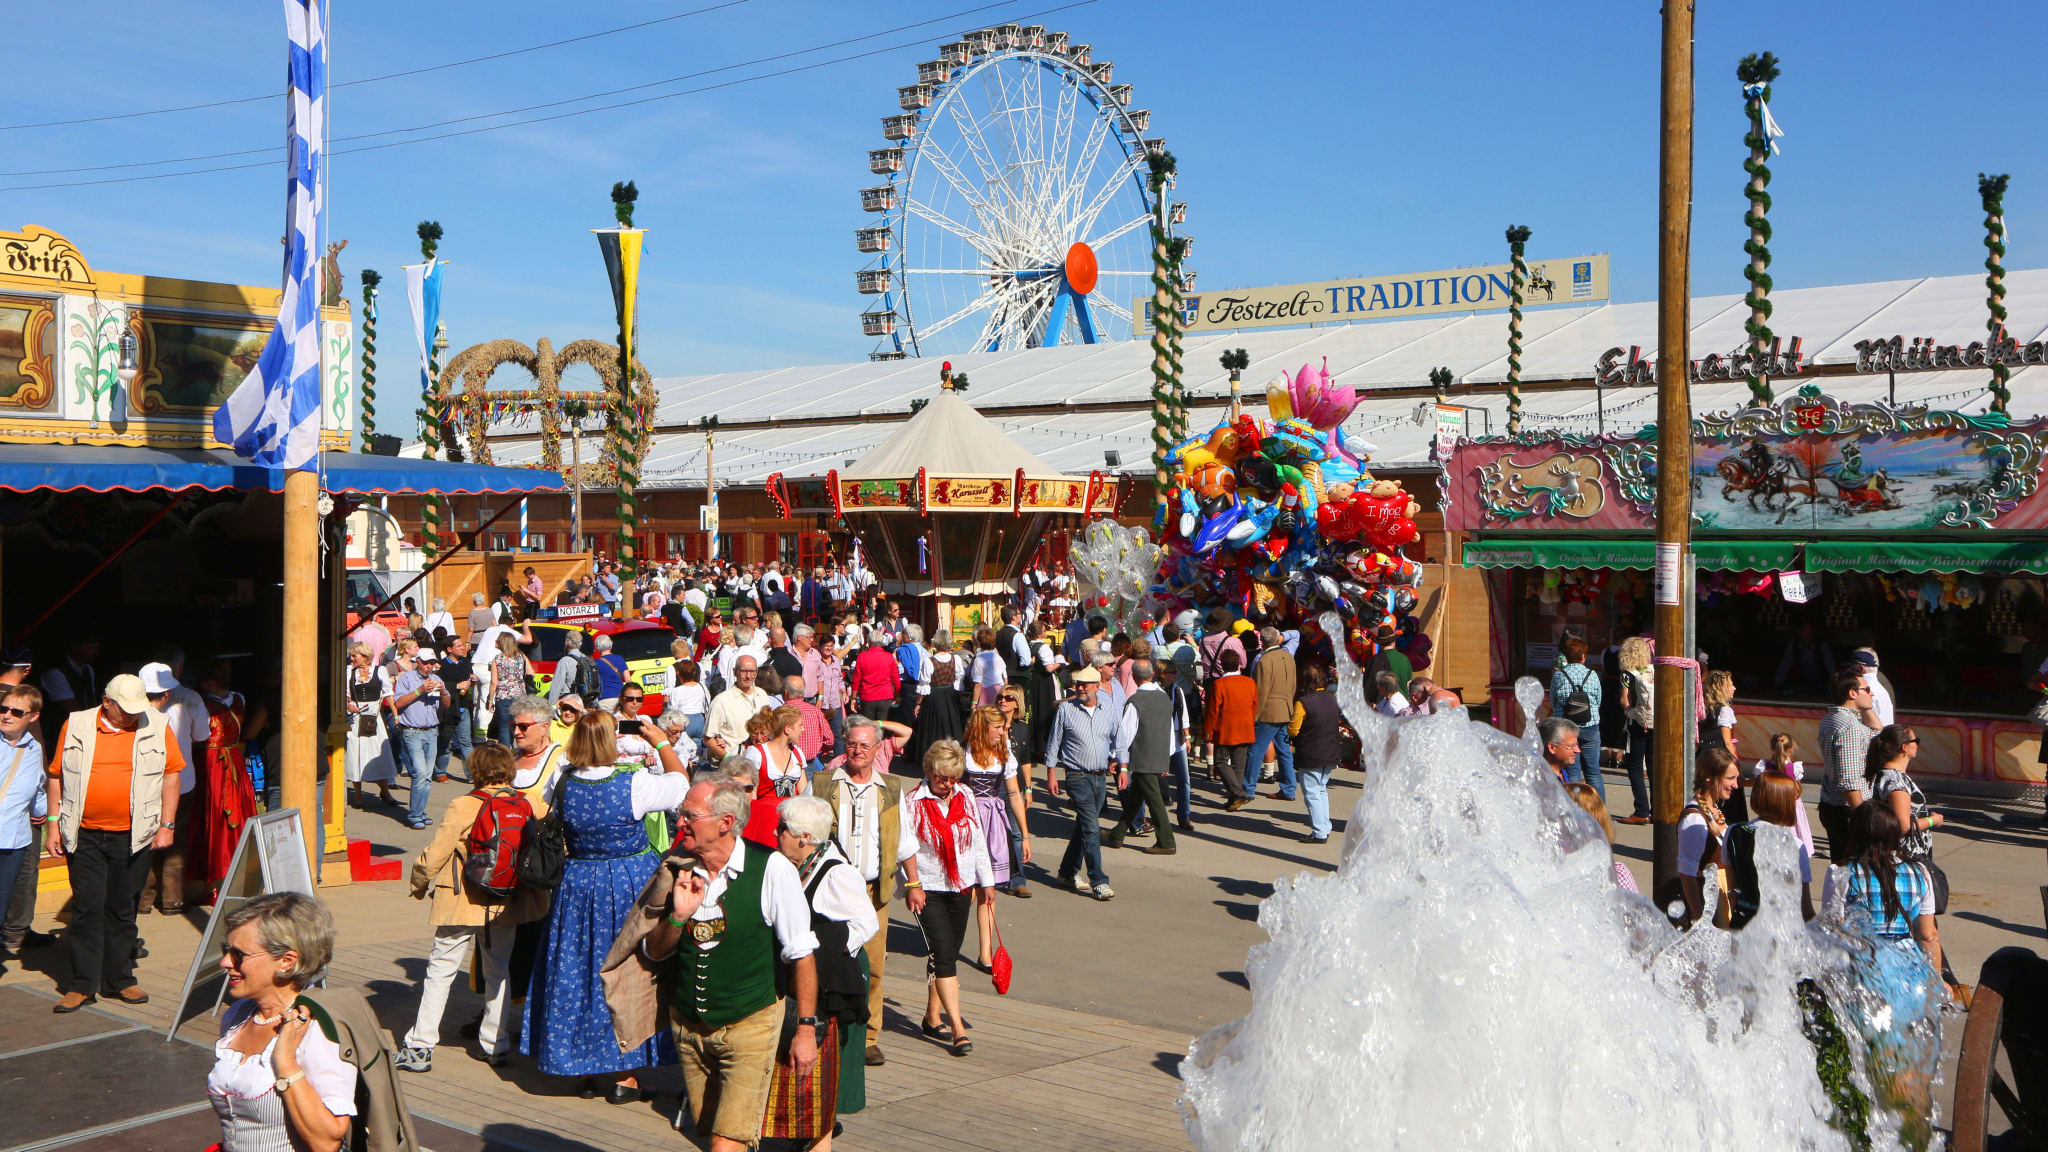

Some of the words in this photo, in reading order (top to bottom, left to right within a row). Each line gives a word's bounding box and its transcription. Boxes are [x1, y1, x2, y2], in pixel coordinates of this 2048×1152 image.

[6, 241, 73, 282] Fritz
[1207, 290, 1324, 324] Festzelt
[1325, 271, 1511, 314] TRADITION
[951, 486, 990, 498] Karussell
[1559, 553, 1600, 564] Original
[1811, 555, 1861, 566] Original
[1865, 555, 1926, 566] Münchner
[1929, 554, 2030, 568] Büchsenwerfen
[559, 605, 597, 615] NOTARZT
